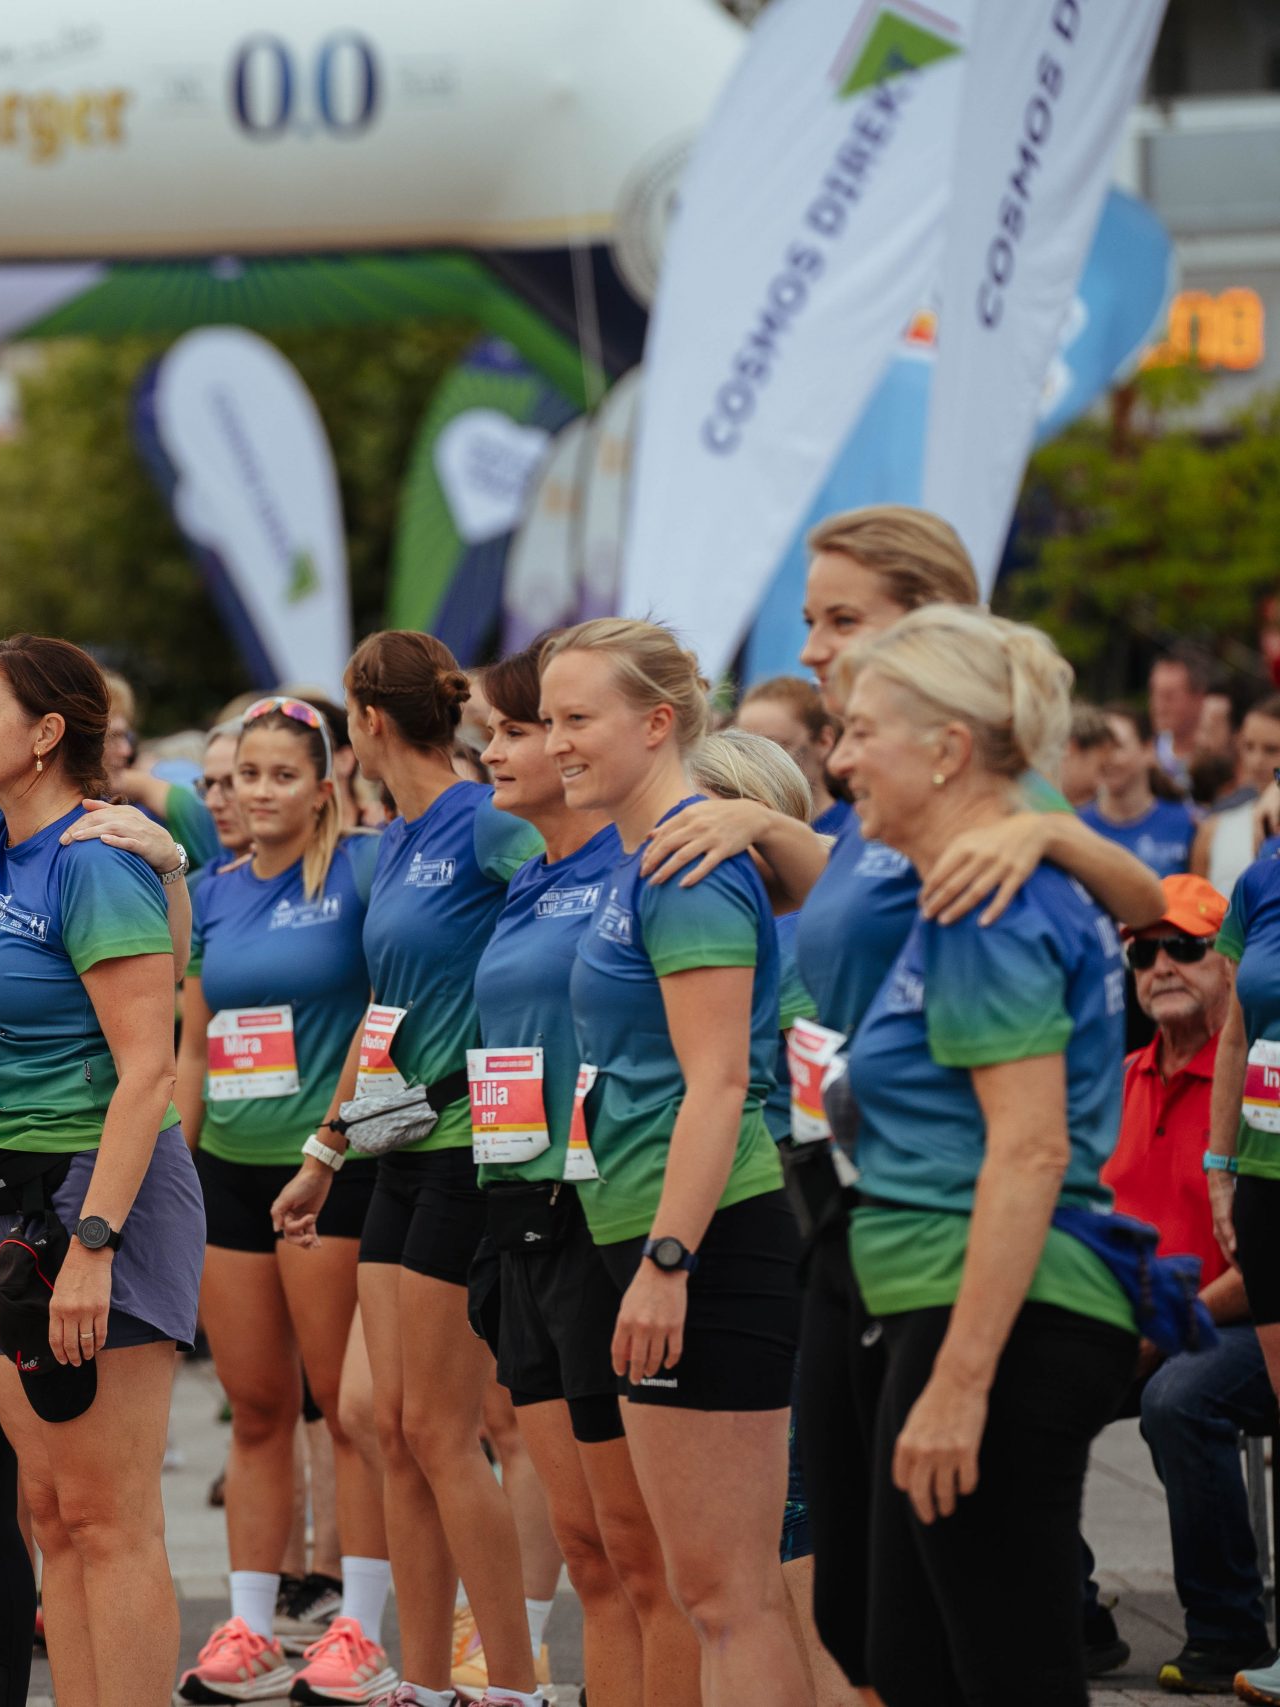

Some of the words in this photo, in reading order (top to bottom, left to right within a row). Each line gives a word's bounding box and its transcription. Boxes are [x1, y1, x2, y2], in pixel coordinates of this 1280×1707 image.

[976, 50, 1064, 330] COSMOS
[700, 243, 825, 457] COSMOS
[473, 1082, 509, 1106] Lilia
[639, 1378, 678, 1388] ummel
